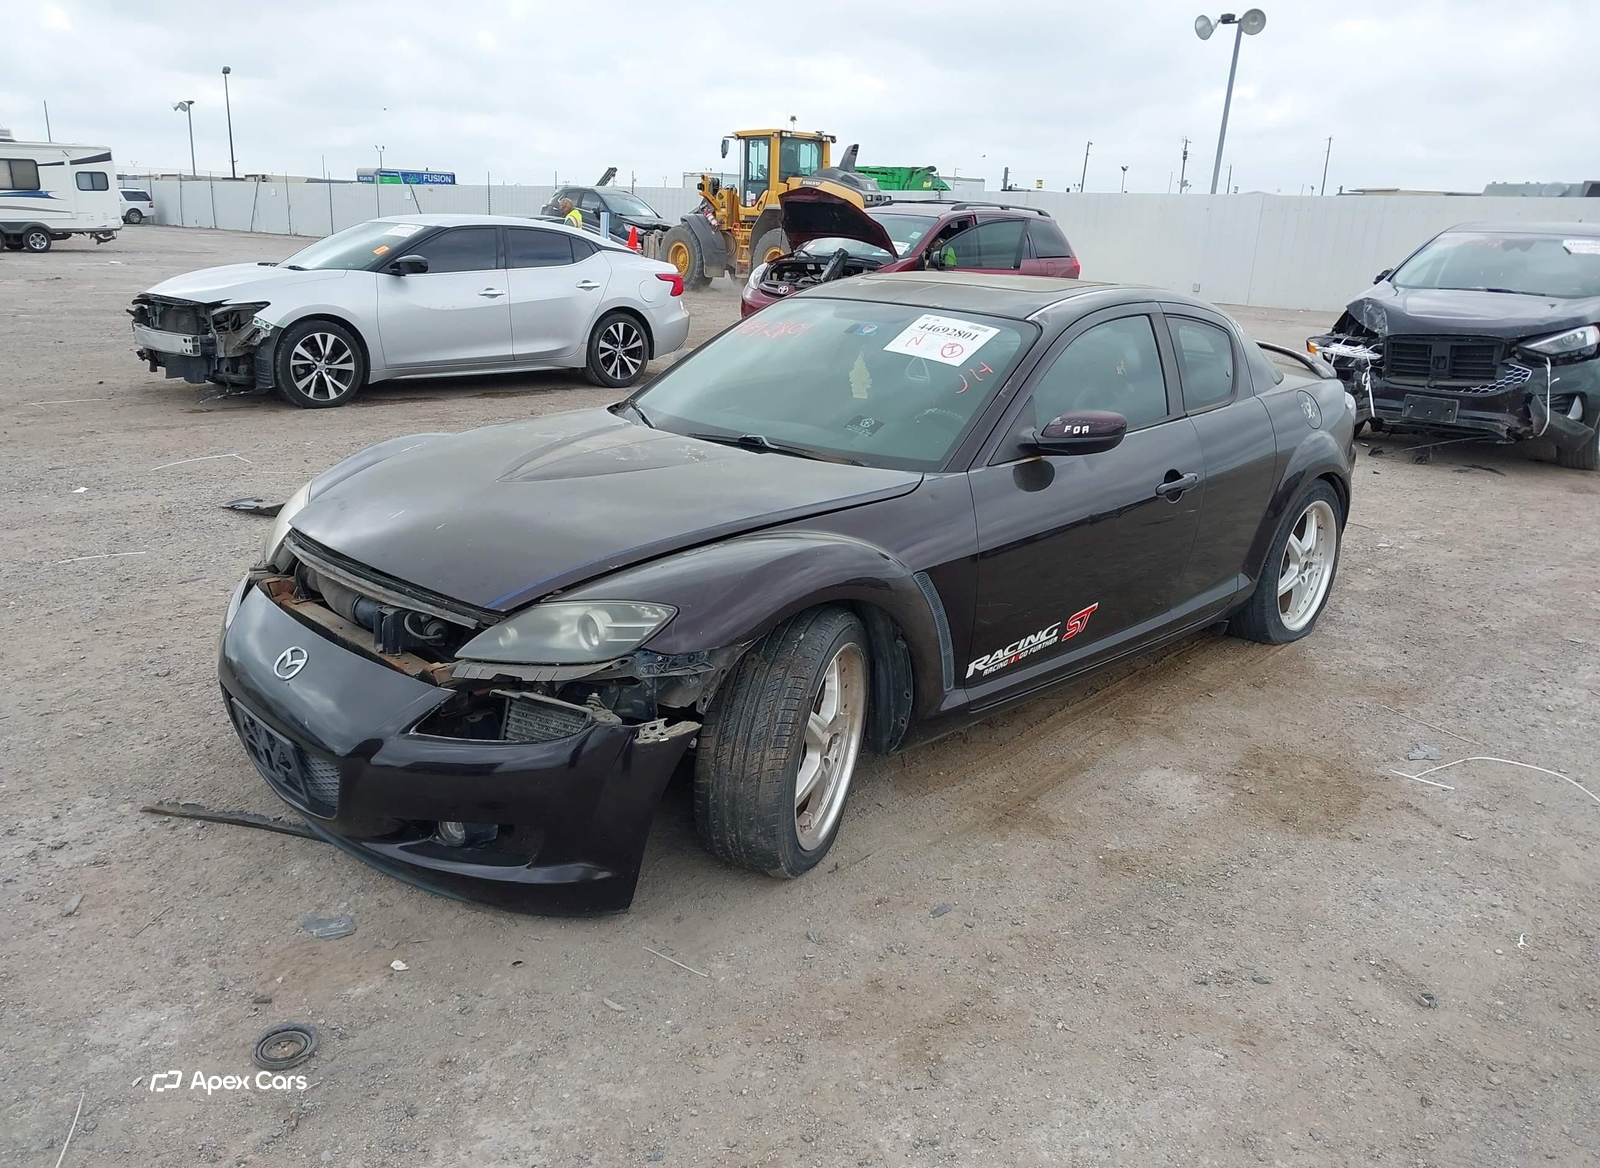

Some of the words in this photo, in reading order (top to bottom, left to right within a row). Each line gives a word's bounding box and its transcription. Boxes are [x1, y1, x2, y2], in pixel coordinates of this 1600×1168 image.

[423, 174, 451, 183] FUSION
[918, 323, 979, 341] 44692801
[965, 621, 1061, 679] RACING
[1061, 602, 1099, 642] ST
[983, 660, 1008, 677] RACING
[1028, 636, 1059, 654] FURTHER
